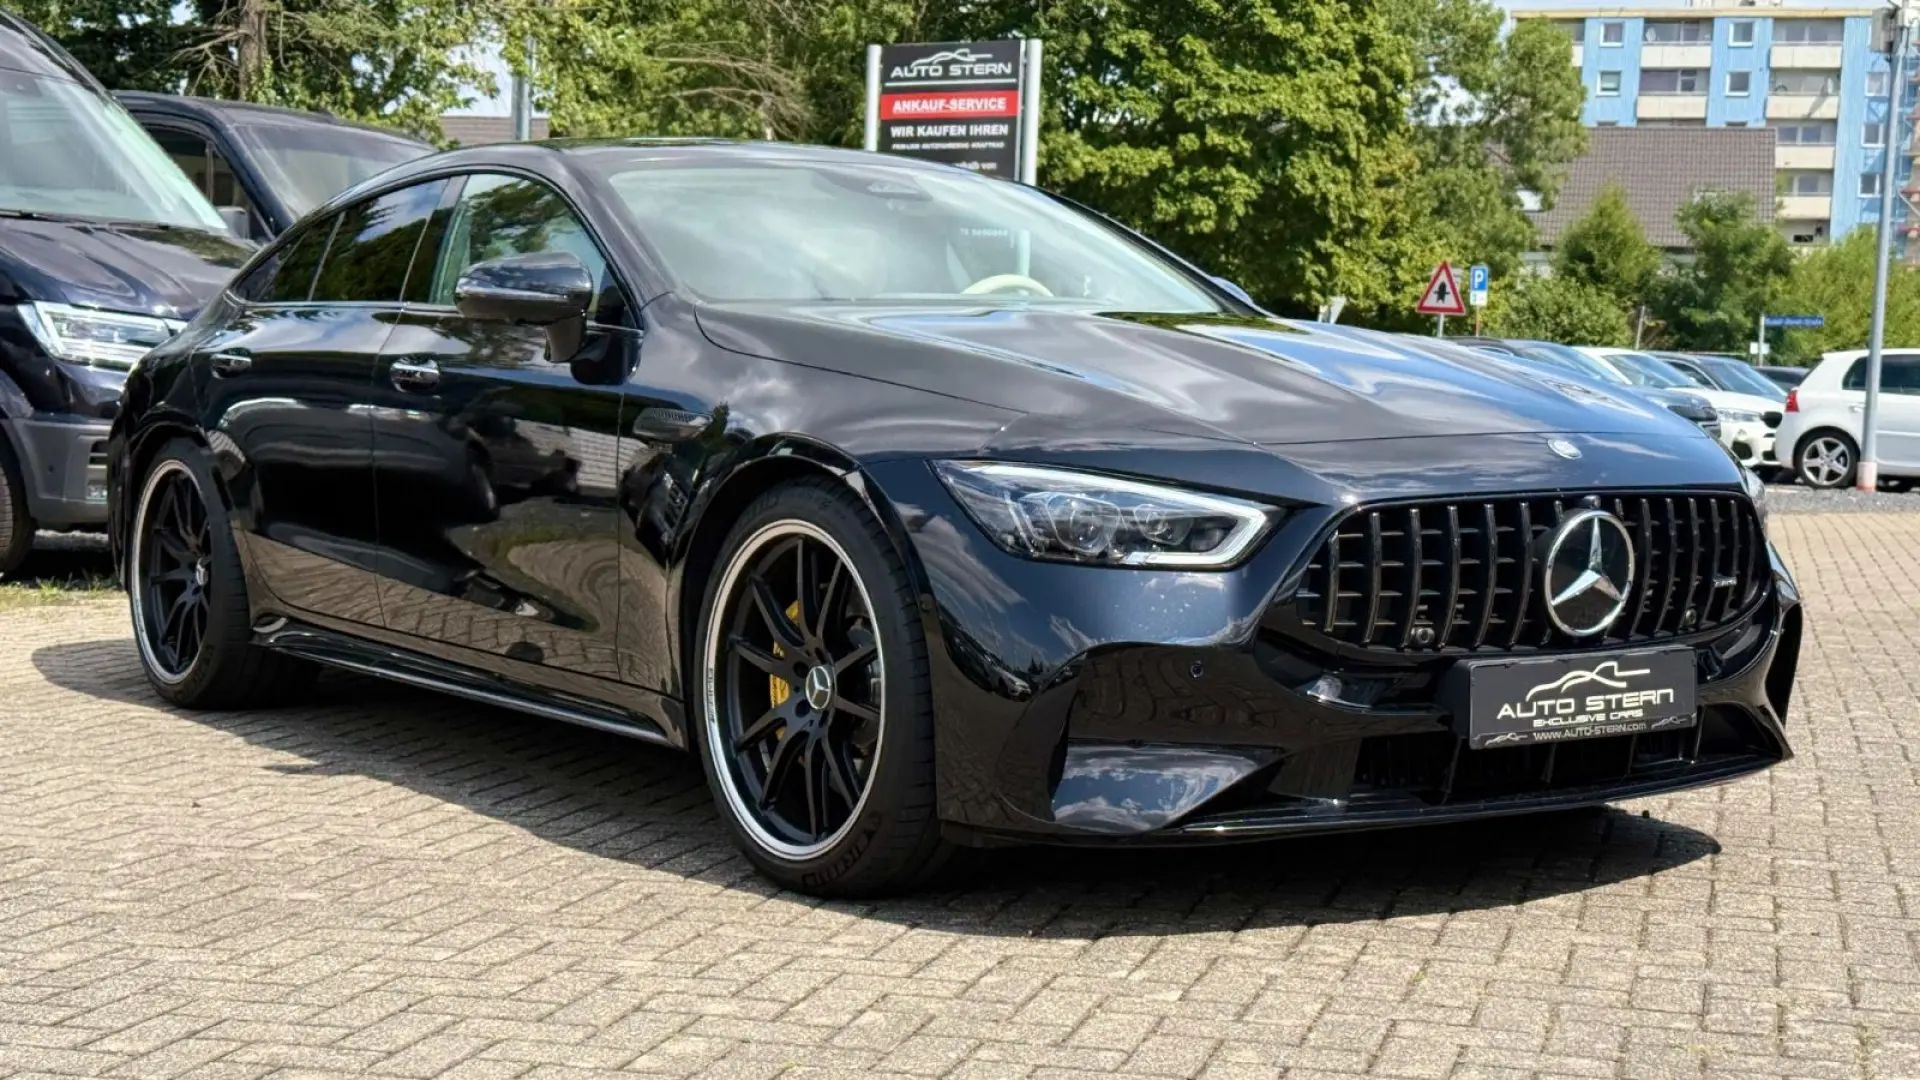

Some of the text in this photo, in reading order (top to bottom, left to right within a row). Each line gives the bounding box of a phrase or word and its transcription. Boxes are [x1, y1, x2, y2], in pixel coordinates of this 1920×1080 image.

[890, 62, 1012, 78] AUTO STERN
[892, 97, 1007, 114] ANKAUF-SERVICE
[890, 124, 1009, 138] WIR KAUFEN IHREN
[1474, 269, 1484, 288] P
[1496, 688, 1674, 720] AUTO STERN
[1533, 709, 1644, 727] EXCLUSIVE CARS
